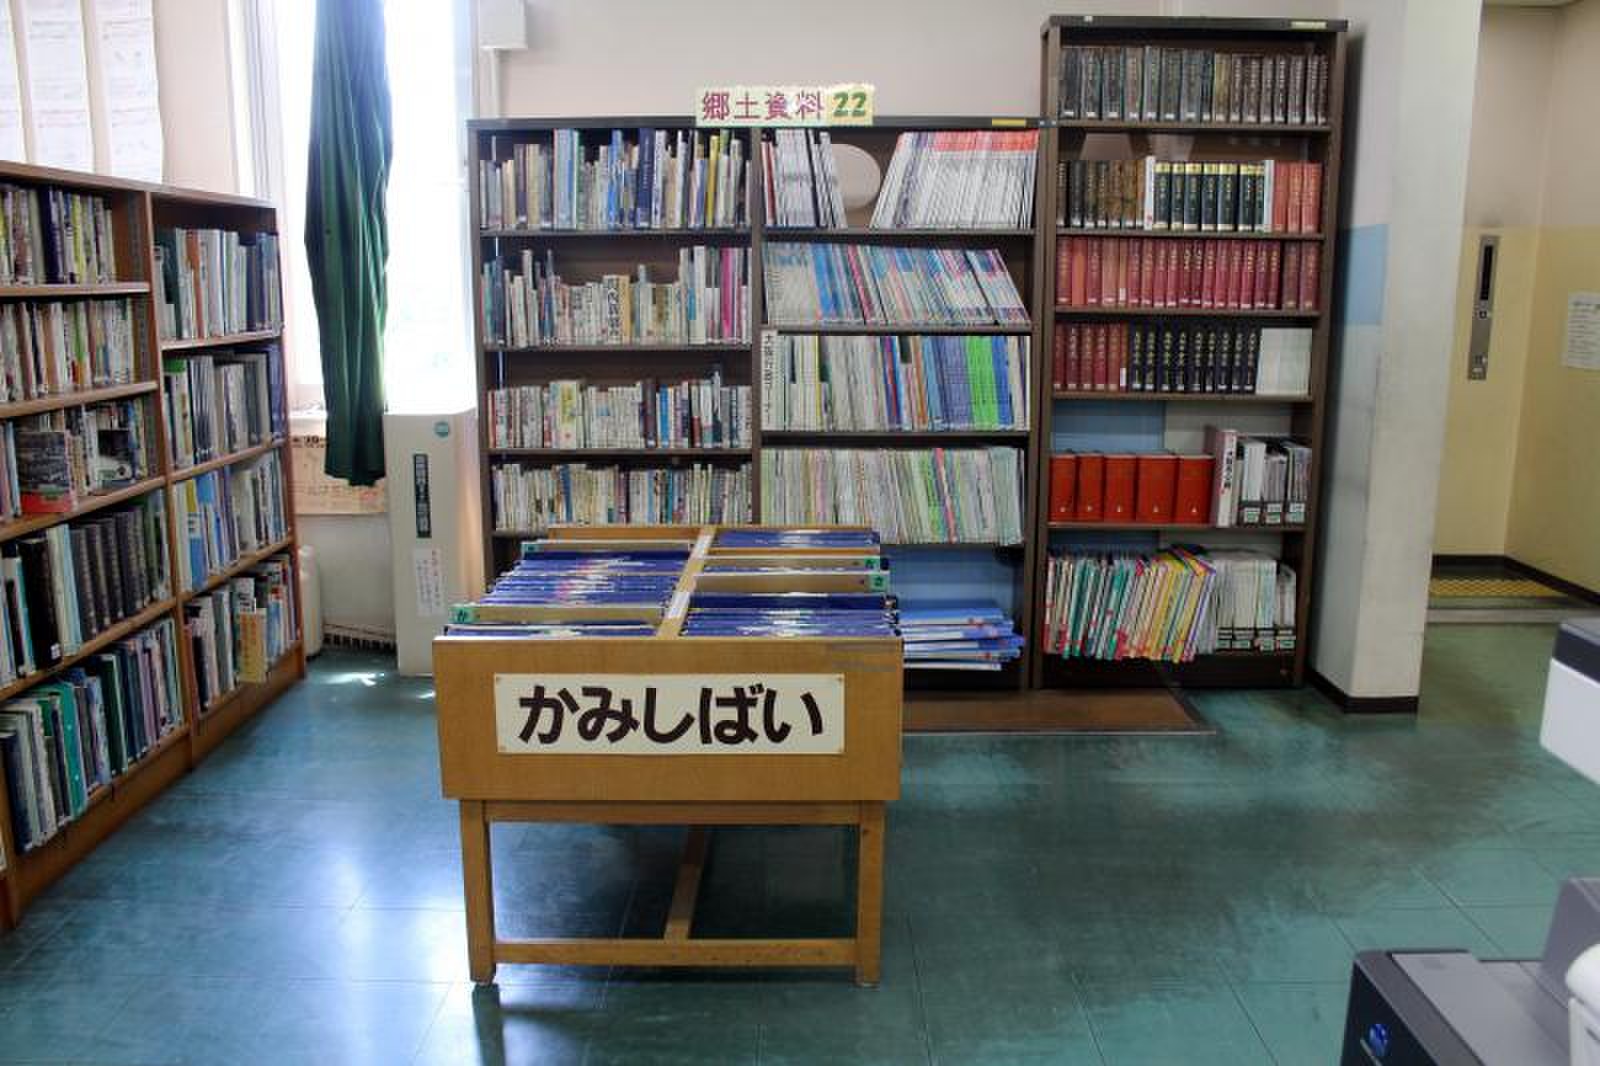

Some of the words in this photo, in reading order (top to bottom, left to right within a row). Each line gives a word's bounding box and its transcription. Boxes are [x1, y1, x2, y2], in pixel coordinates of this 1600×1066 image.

[702, 90, 824, 121] 郷土資料
[833, 91, 867, 118] 22
[518, 683, 824, 746] かみしばい
